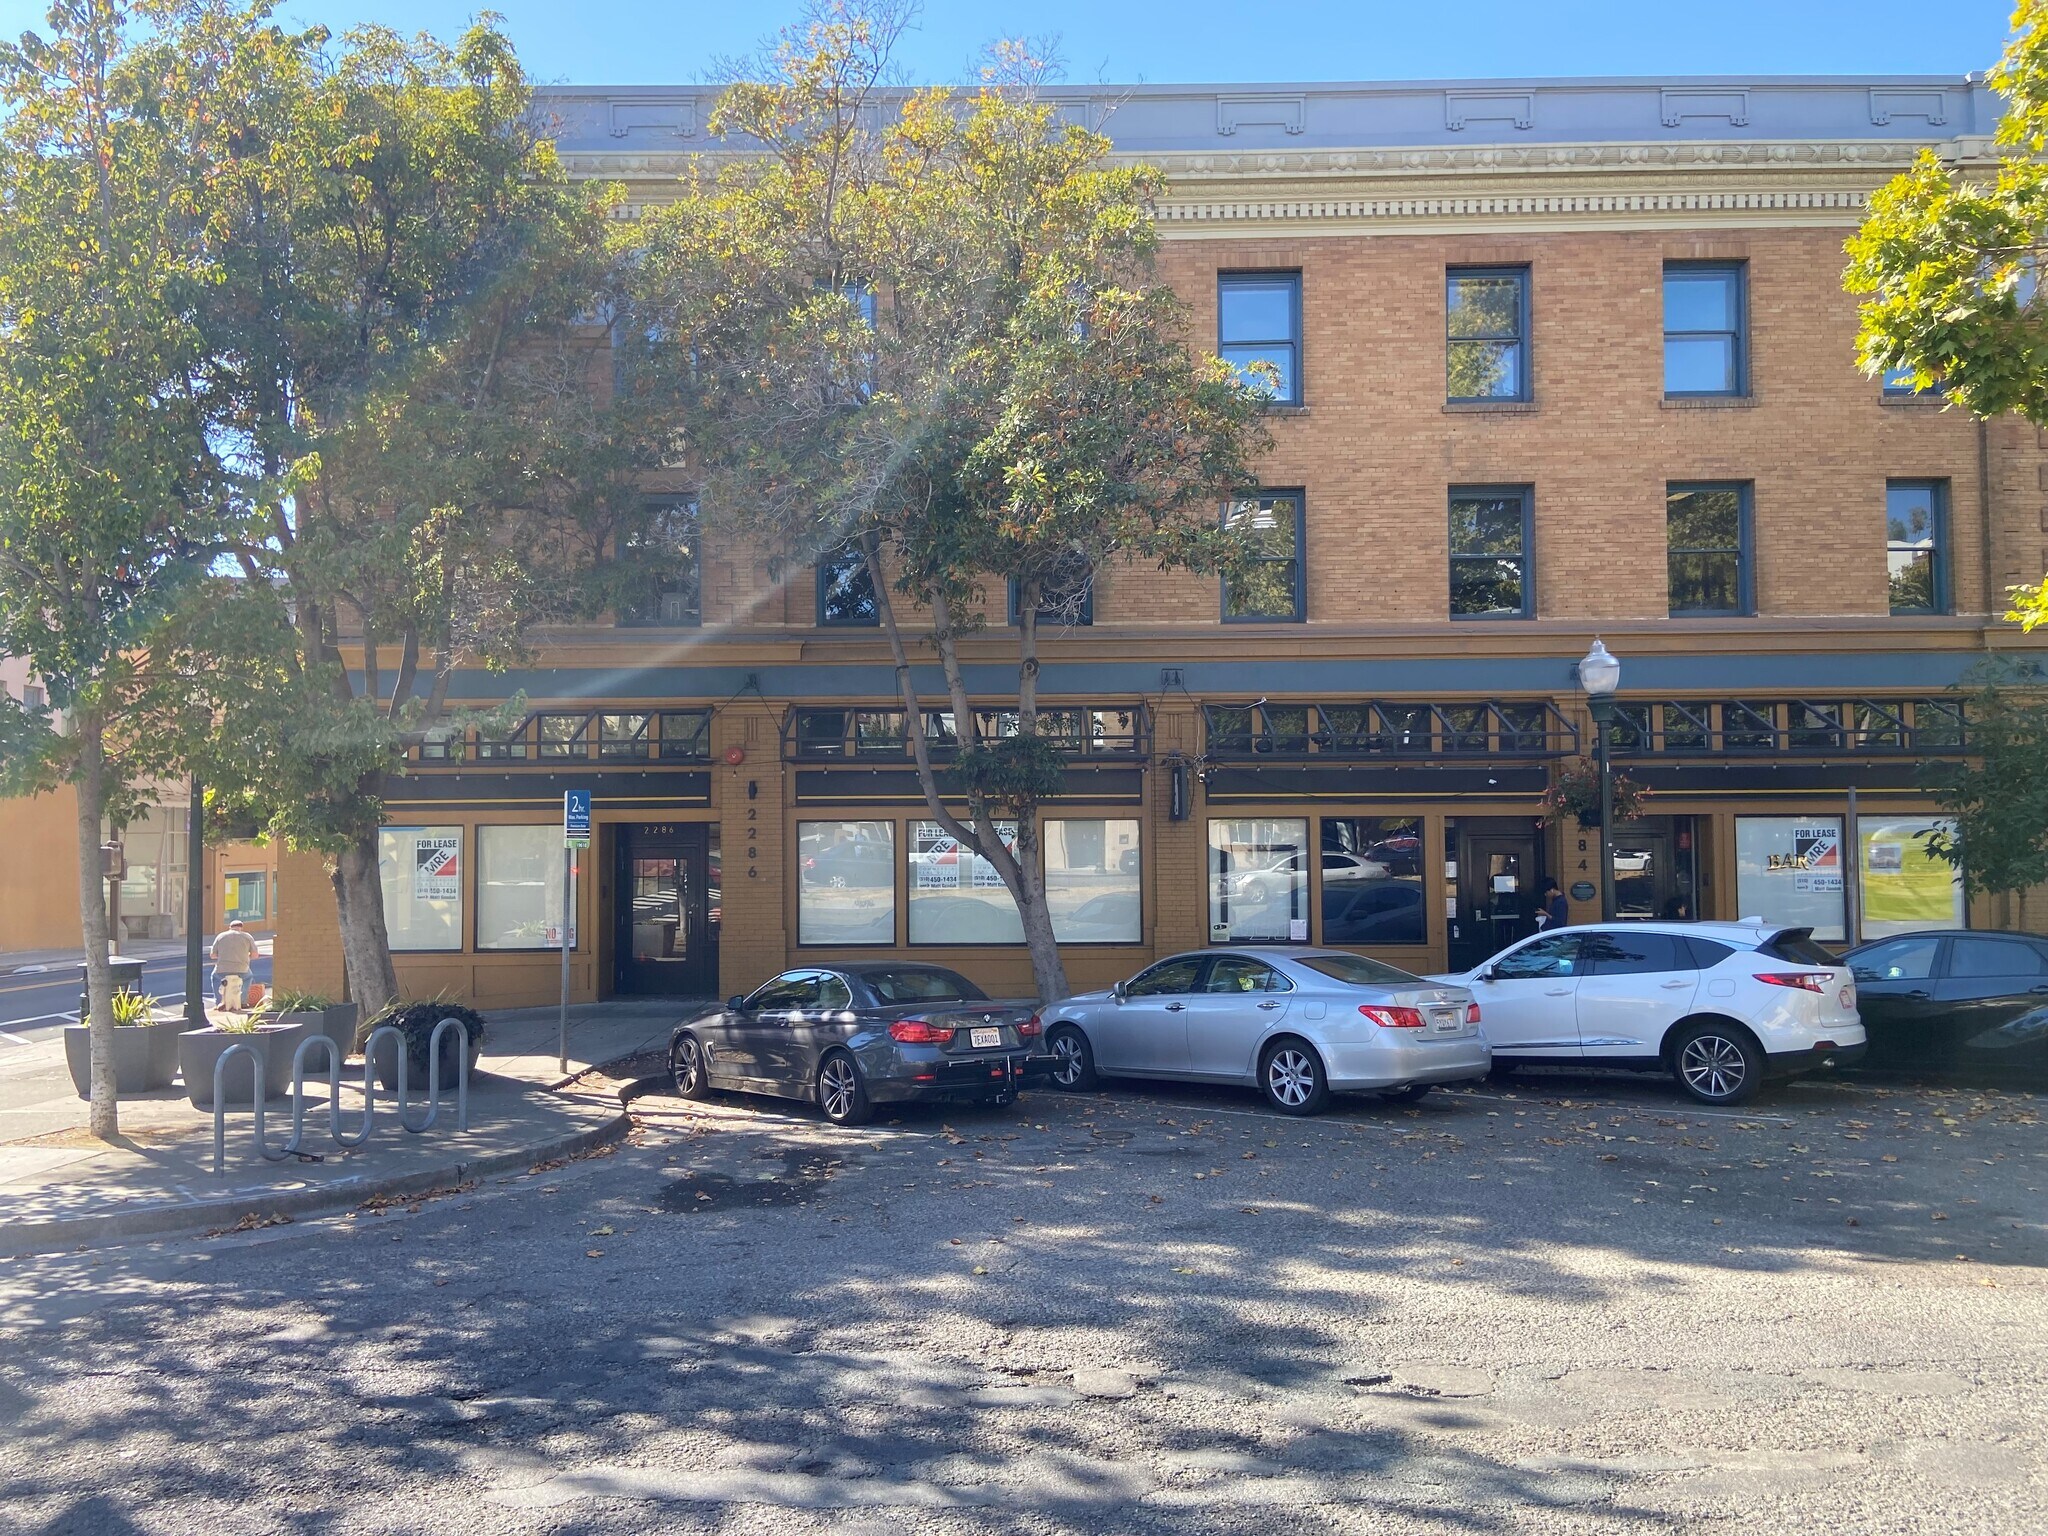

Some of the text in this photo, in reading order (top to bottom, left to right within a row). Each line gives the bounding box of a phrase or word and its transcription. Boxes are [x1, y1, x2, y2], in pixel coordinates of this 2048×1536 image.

[572, 796, 578, 812] 2
[644, 826, 673, 834] 2286
[1813, 829, 1836, 837] LEASE
[417, 840, 457, 848] FOR LEASE
[748, 808, 757, 878] 2286
[1806, 840, 1829, 865] MRE
[1767, 853, 1809, 870] BAR
